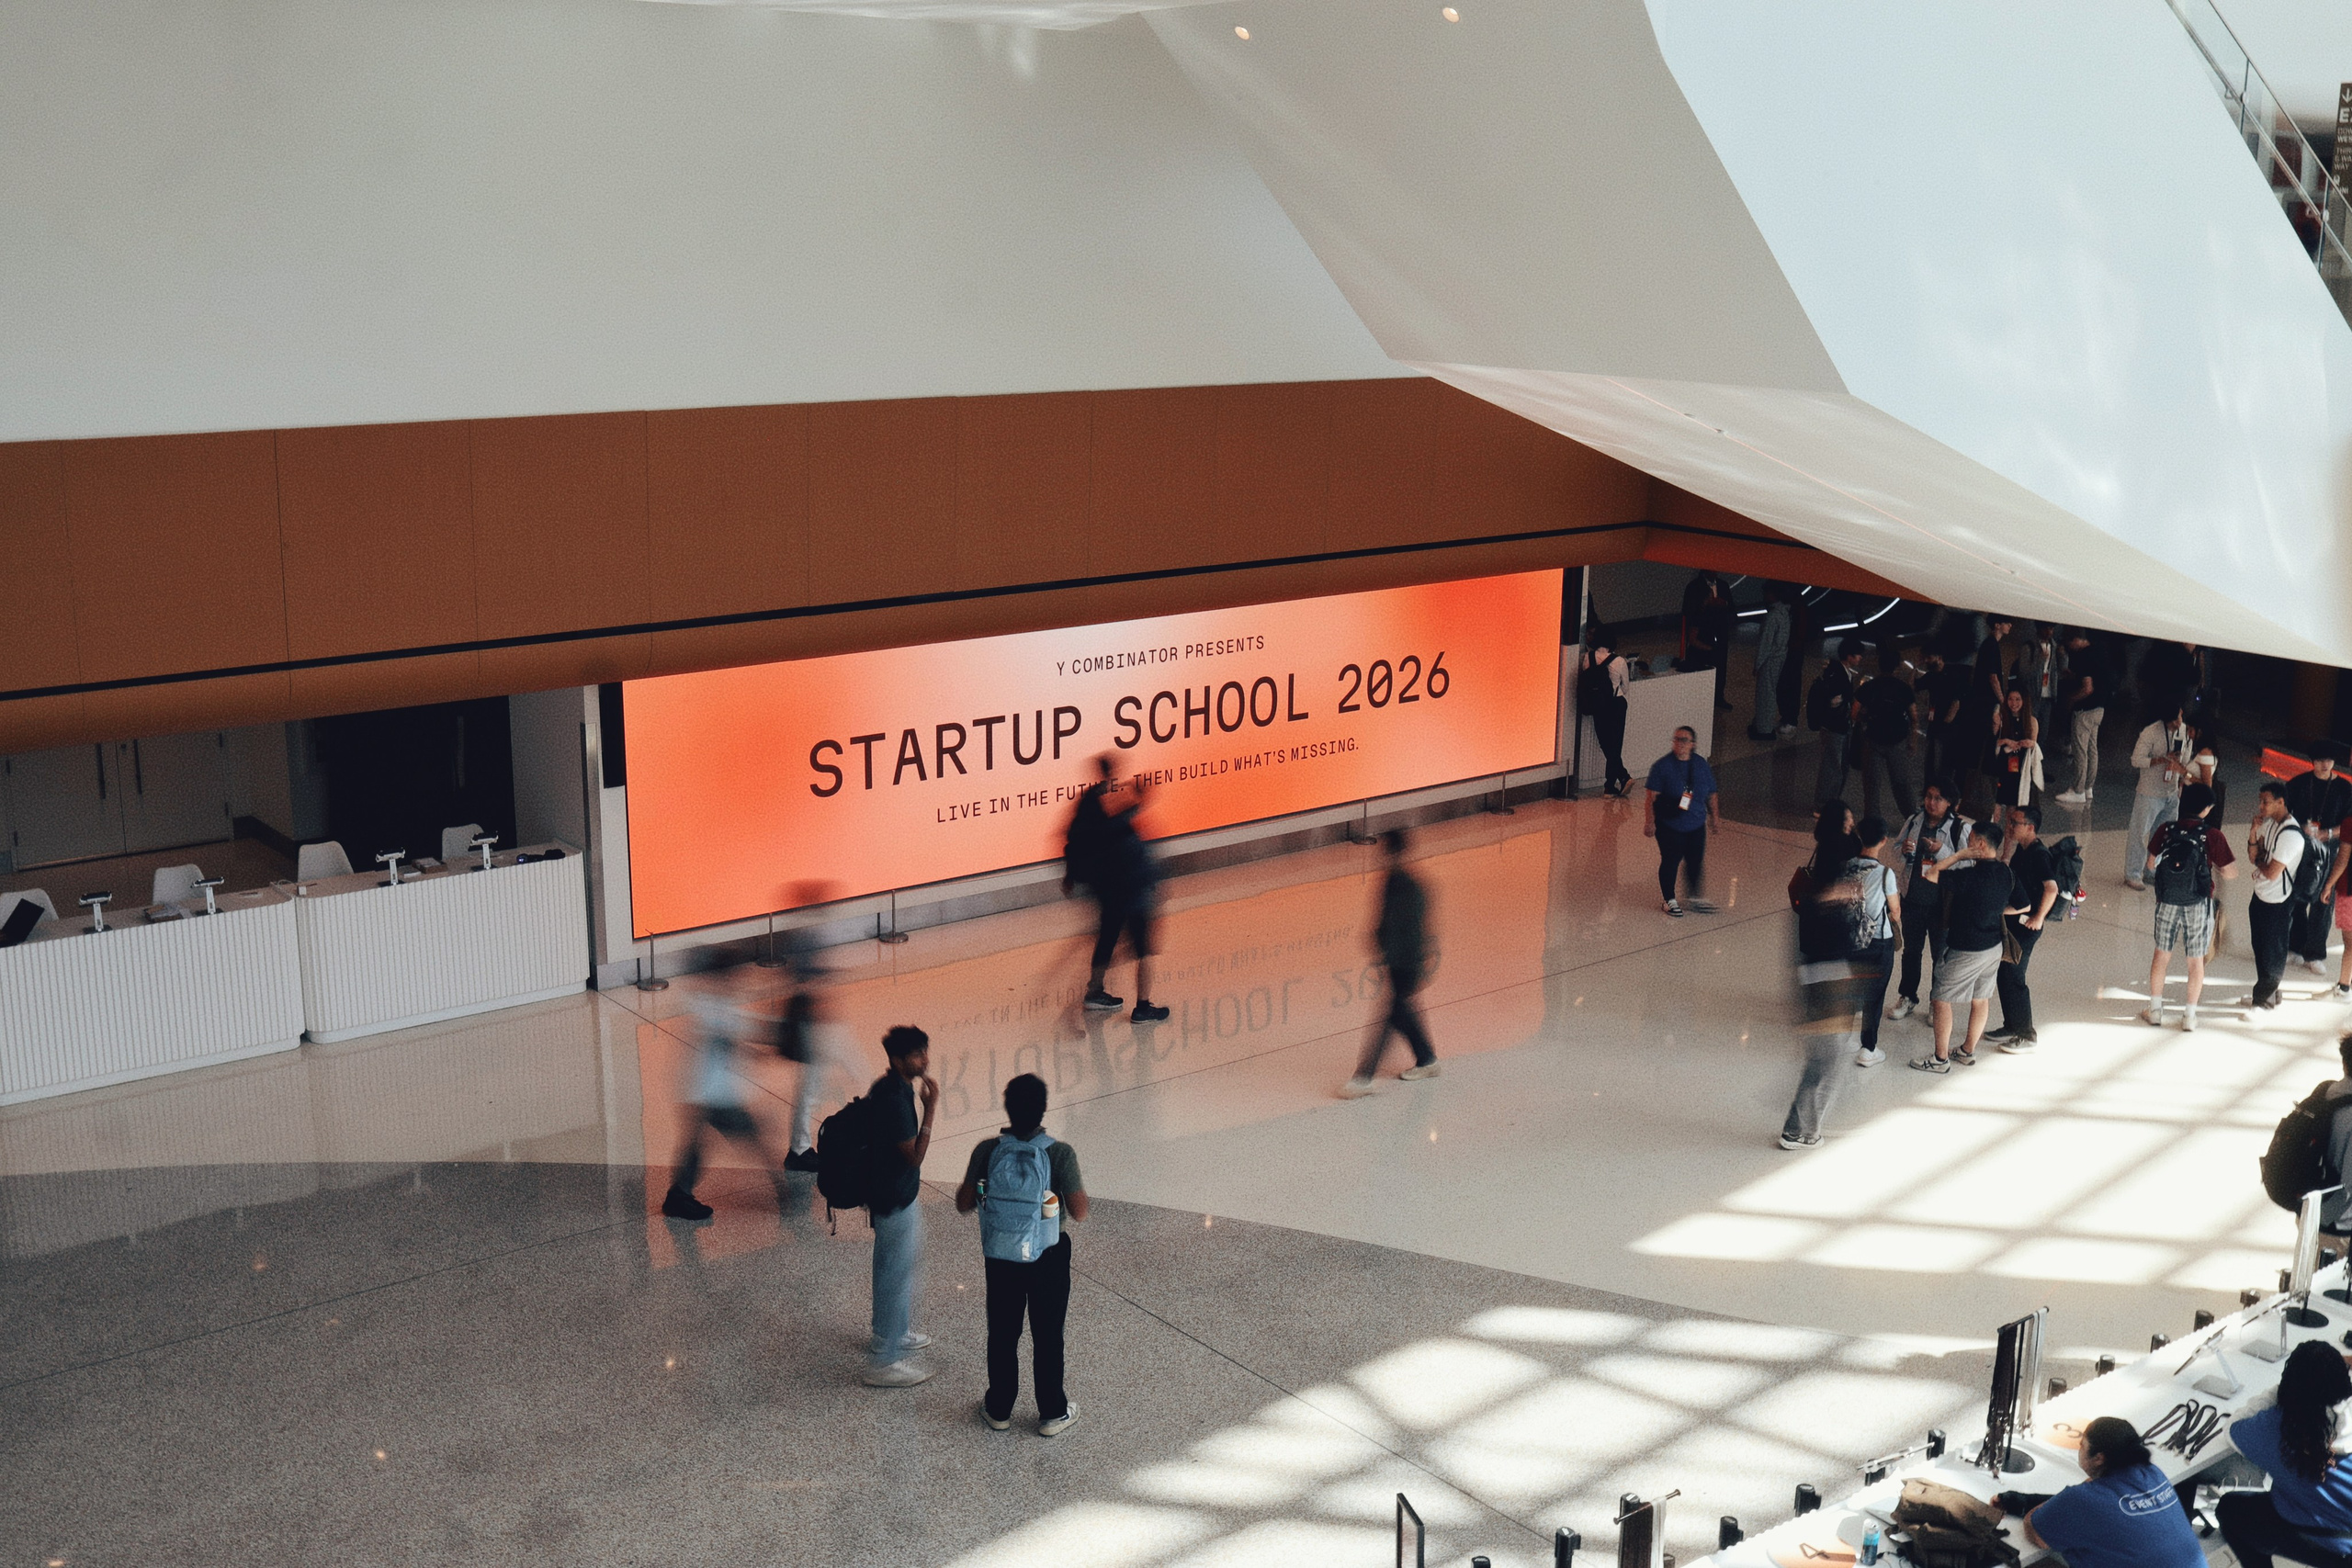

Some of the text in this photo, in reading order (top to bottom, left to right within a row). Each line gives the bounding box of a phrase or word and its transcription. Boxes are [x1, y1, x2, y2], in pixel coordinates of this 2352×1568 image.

[2339, 107, 2352, 123] E
[1057, 636, 1265, 676] Y COMBINATOR PRESENTS
[809, 650, 1451, 798] STARTUP SCHOOL 2026
[937, 738, 1360, 823] LIVE IN THE FUTE. THEN BUILD WHAT'S MISSING.
[2128, 1495, 2157, 1511] EVENT
